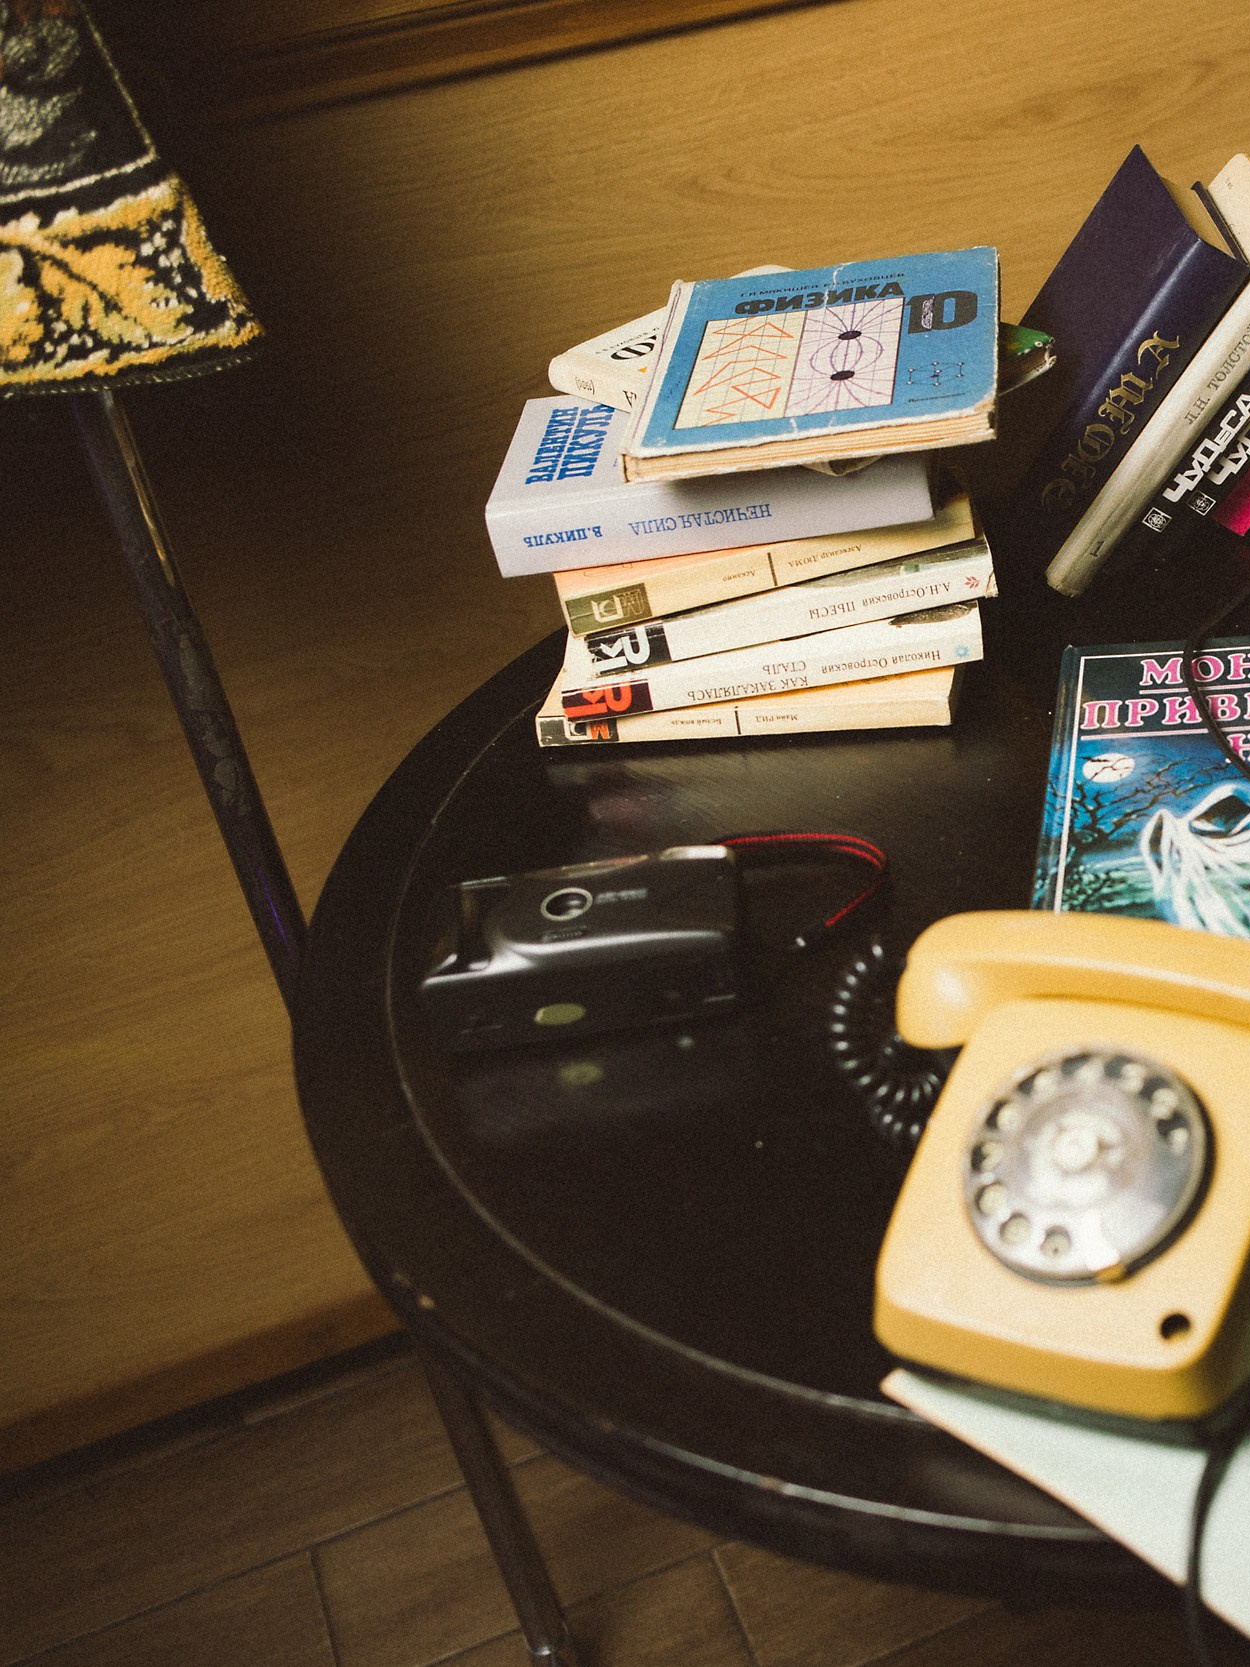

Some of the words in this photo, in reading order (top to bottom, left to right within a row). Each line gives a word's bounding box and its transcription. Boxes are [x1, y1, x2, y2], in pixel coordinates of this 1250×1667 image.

[734, 281, 905, 315] ФИЗИКА
[904, 290, 979, 335] 10
[525, 406, 579, 484] ВАЛЕНТИН
[556, 403, 616, 480] ПИКУЛЬ
[678, 503, 773, 529] НЕЧИСТАЯ
[523, 525, 603, 548] В.ПИКУЛЬ
[628, 517, 677, 536] СИЛА
[788, 555, 819, 568] ДЮМА
[821, 545, 862, 559] Александр
[862, 582, 951, 606] А.Н.Островский
[809, 601, 856, 620] ПЬЕСЫ
[763, 660, 807, 675] СТАЛЬ
[821, 658, 888, 674] Островский
[892, 650, 941, 665] Николай
[687, 679, 777, 701] ЗАКАЛЯЛАСЬ
[781, 676, 809, 687] КАК
